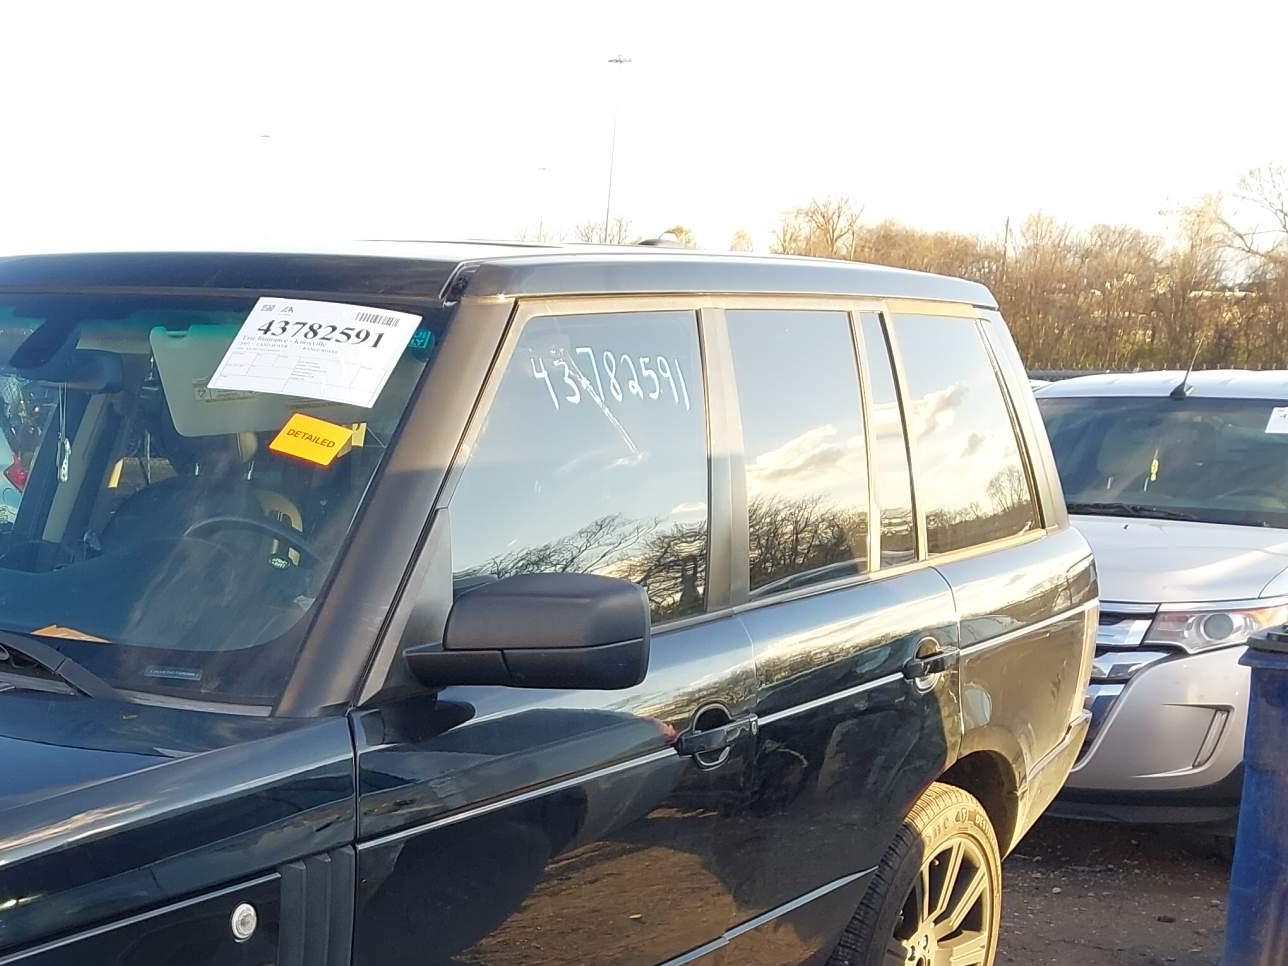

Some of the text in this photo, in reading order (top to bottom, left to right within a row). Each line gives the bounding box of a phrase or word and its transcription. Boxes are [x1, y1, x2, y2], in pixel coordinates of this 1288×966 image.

[257, 318, 385, 348] 43782591
[529, 346, 690, 410] 43782591
[286, 427, 336, 449] DETAILED
